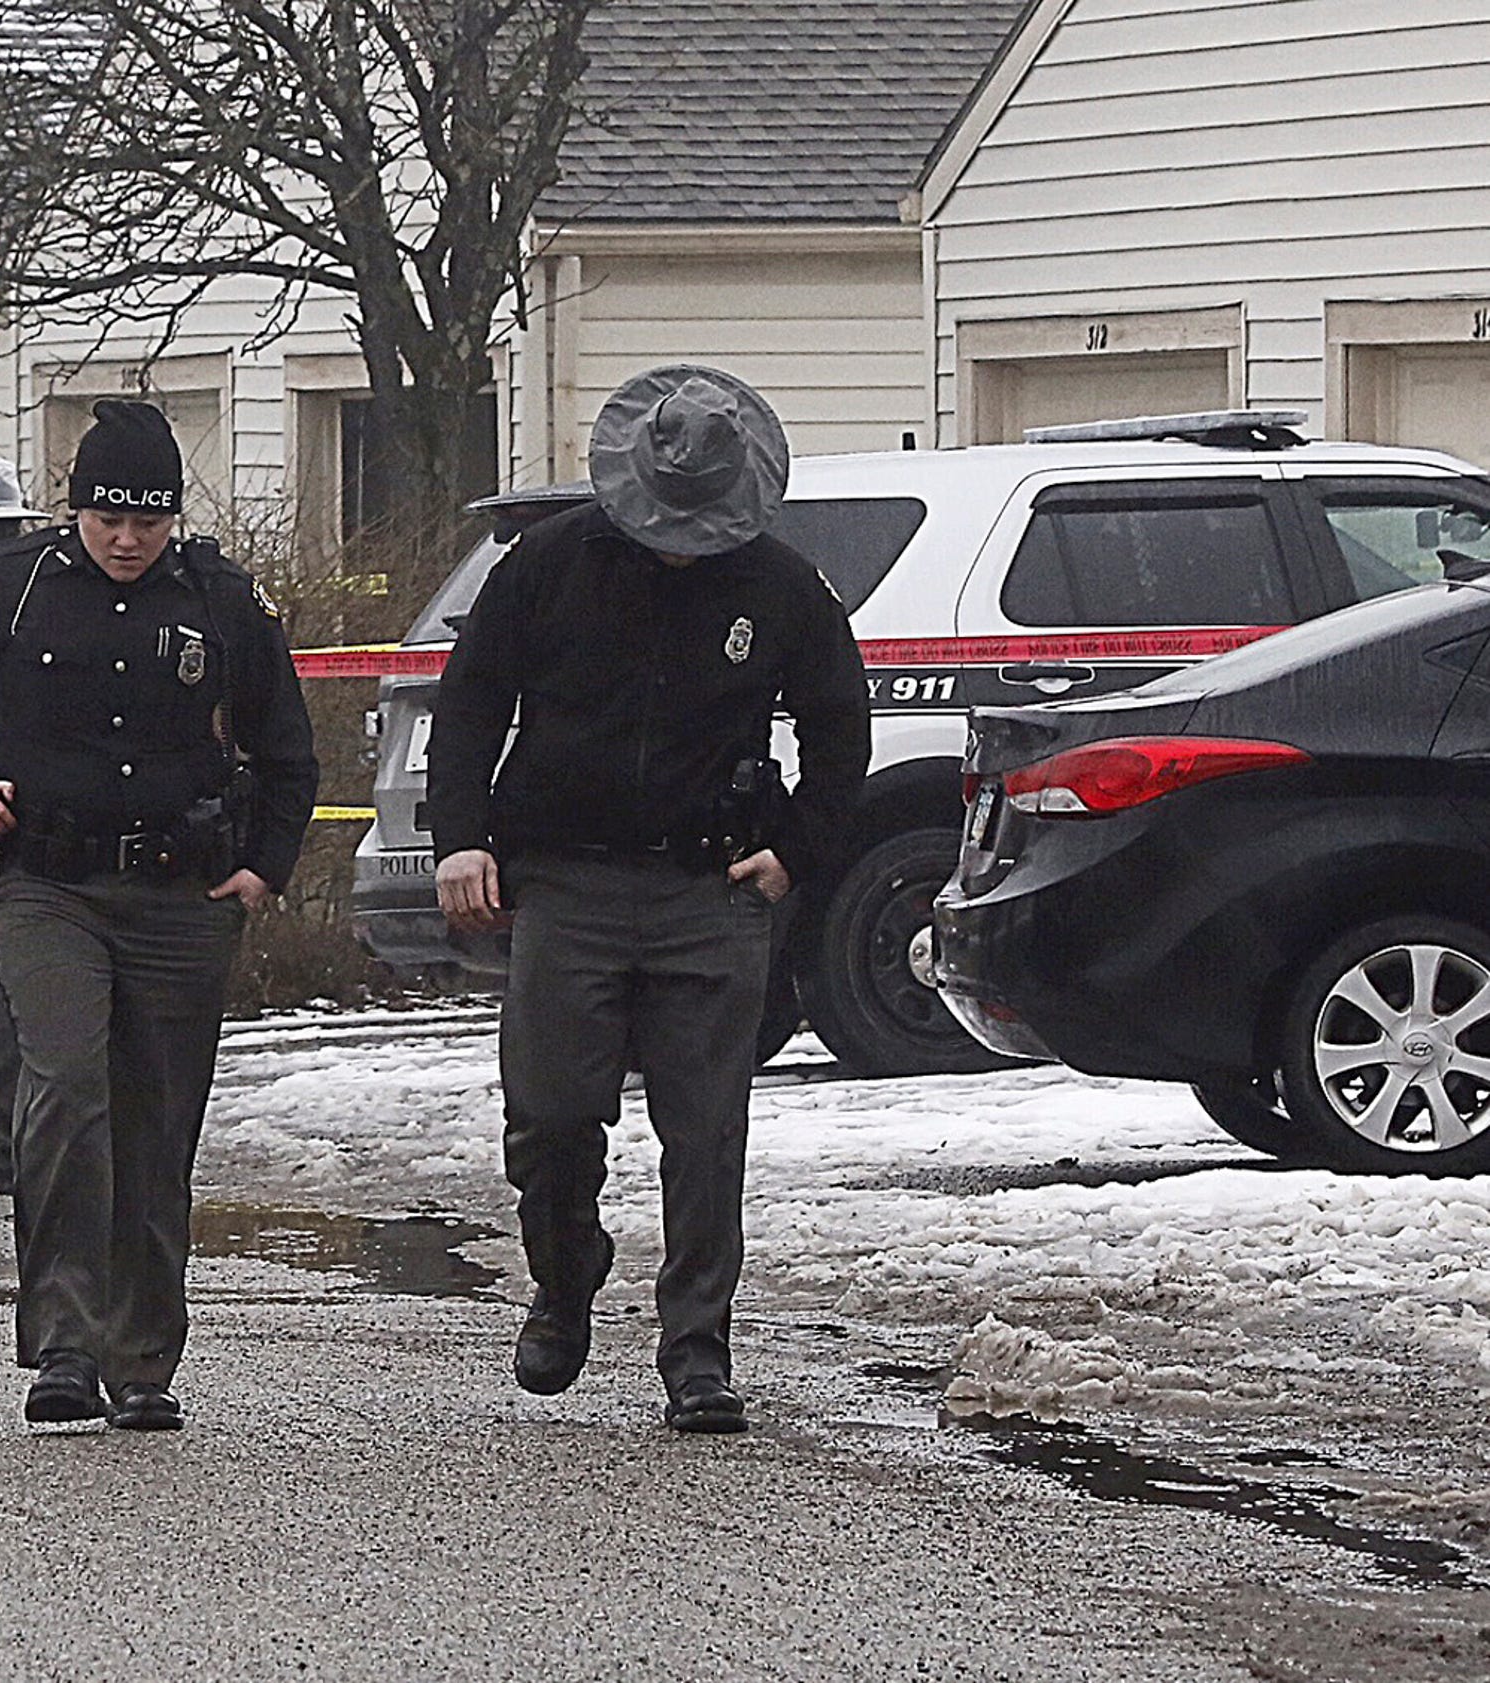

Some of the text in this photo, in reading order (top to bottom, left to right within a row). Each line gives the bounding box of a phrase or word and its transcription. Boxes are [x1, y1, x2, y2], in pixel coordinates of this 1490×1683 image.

[1472, 308, 1490, 339] 31
[1086, 324, 1108, 351] 312
[93, 485, 174, 507] POLICE
[866, 676, 956, 700] Y 911
